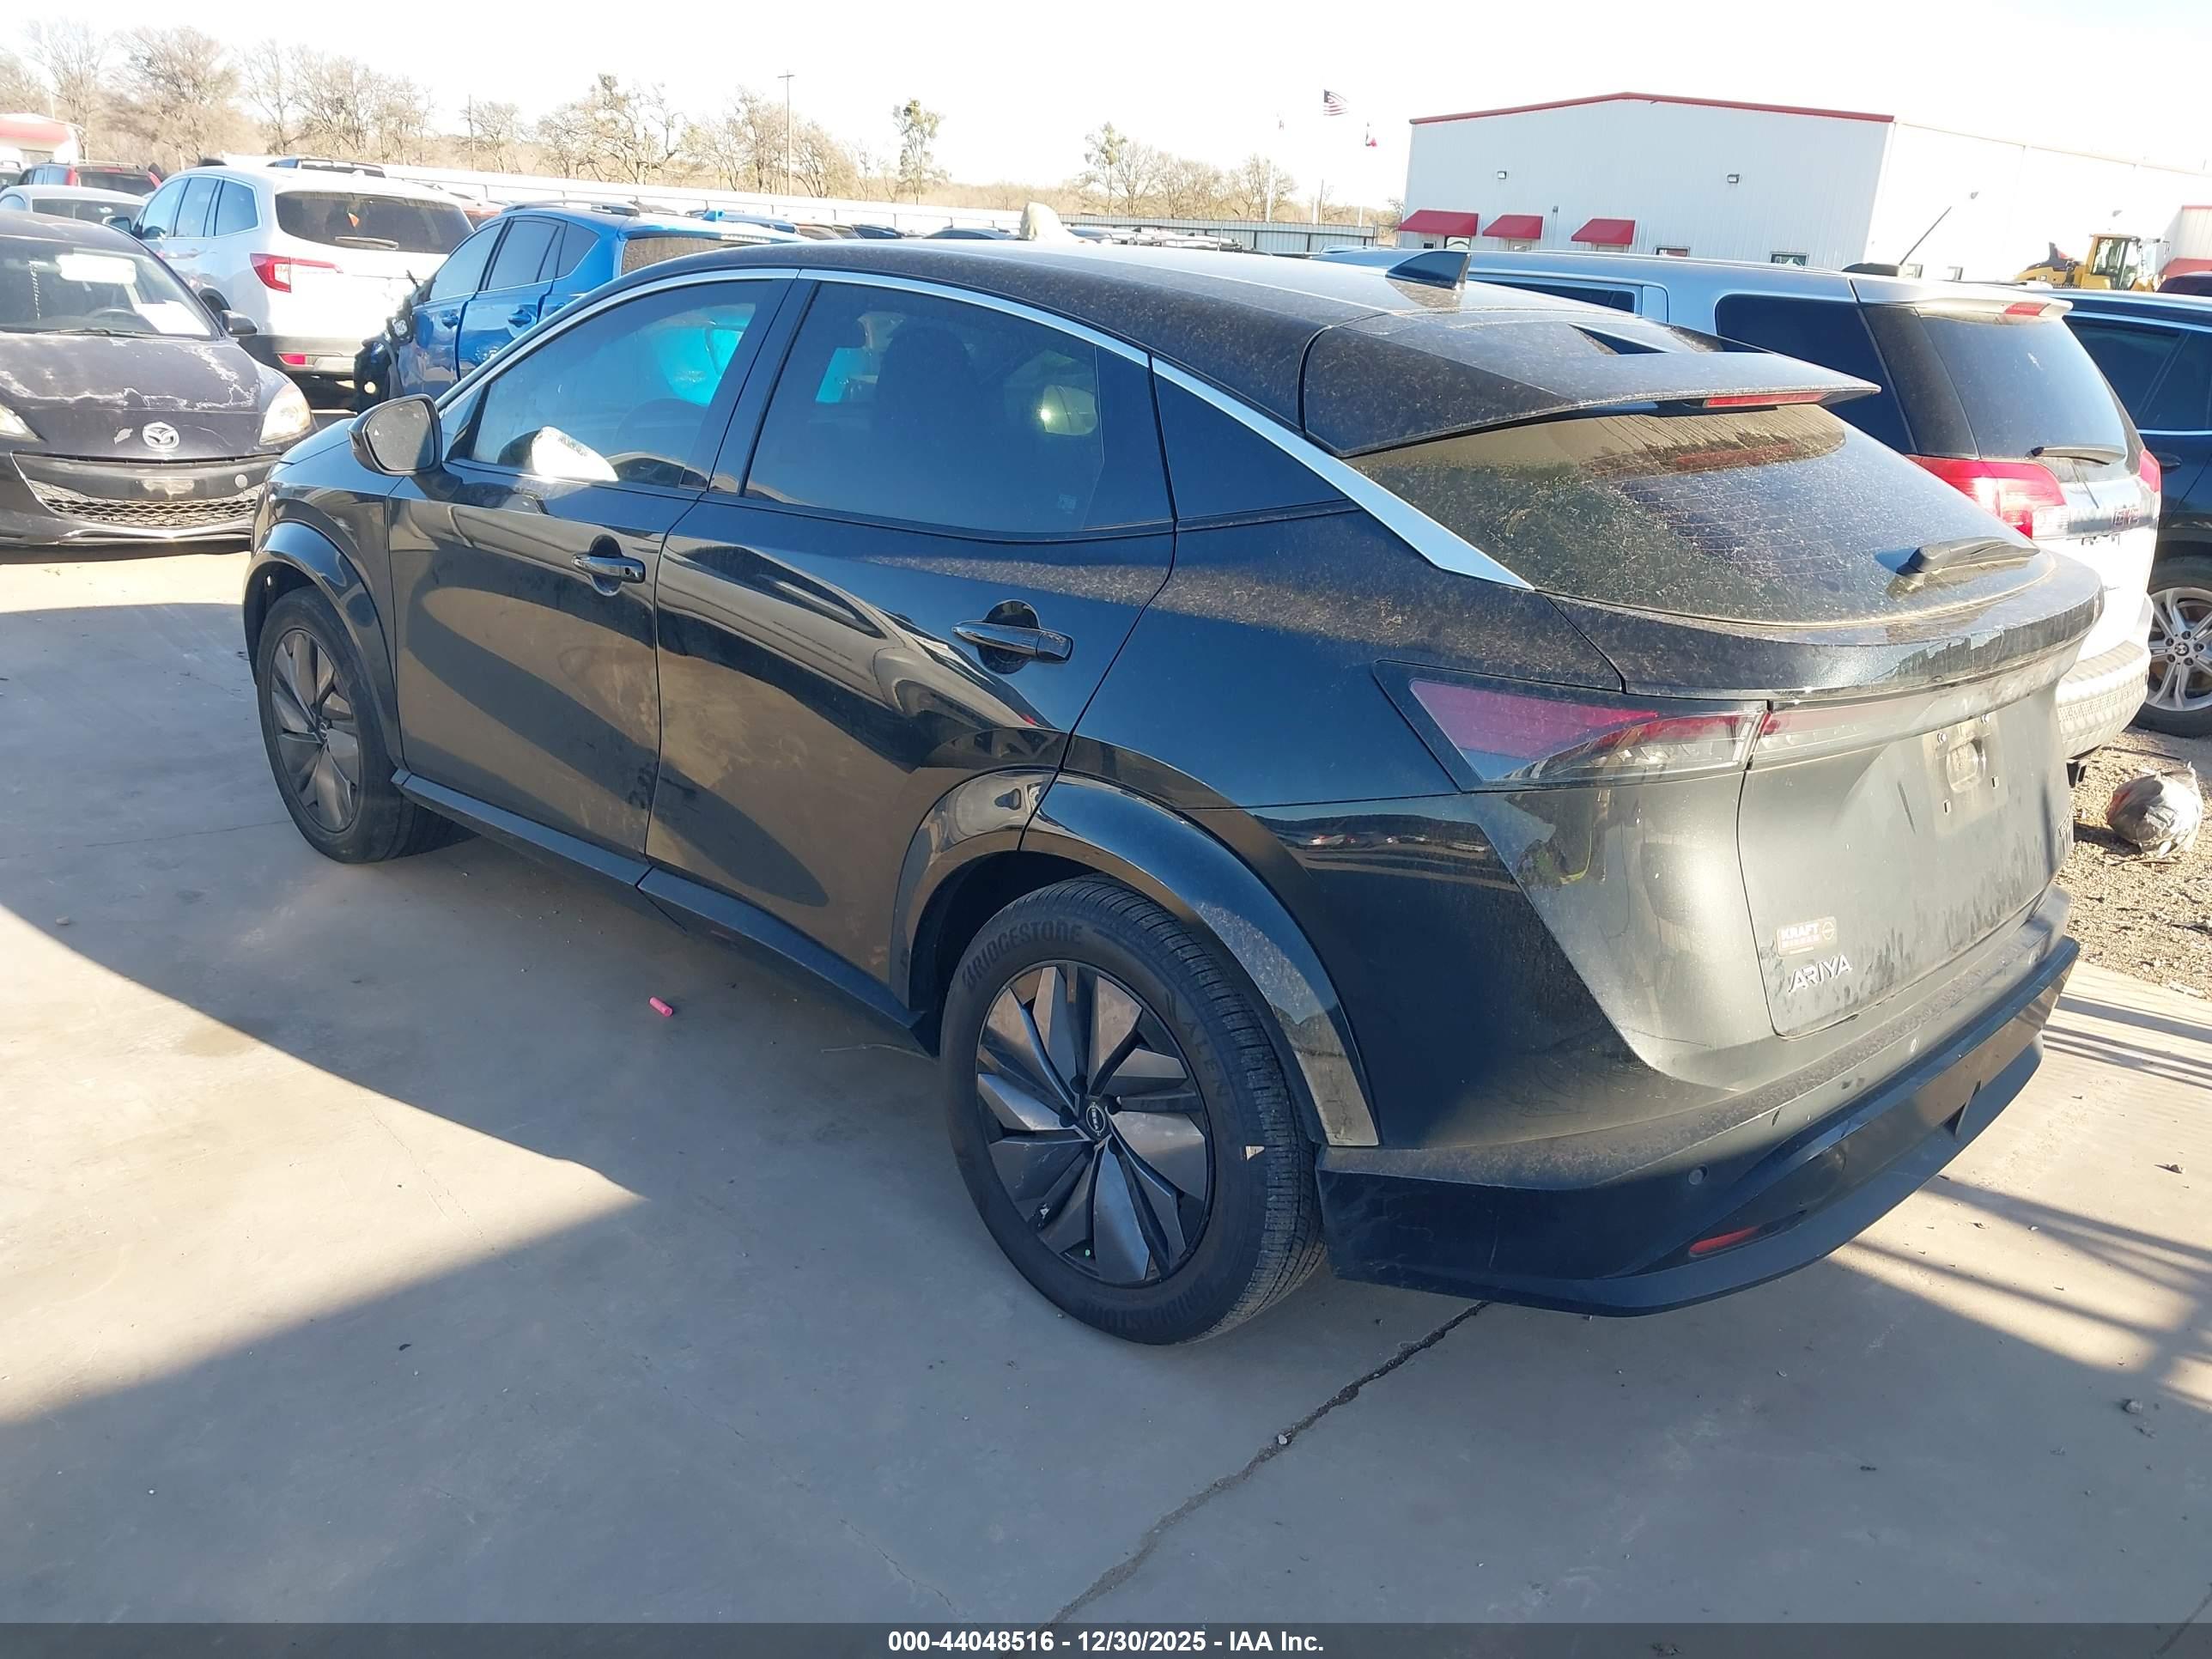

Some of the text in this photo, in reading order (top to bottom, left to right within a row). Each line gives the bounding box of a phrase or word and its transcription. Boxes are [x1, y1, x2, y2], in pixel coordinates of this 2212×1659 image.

[1780, 922, 1820, 941] KRAFT
[961, 920, 1083, 989] BRIDGESTONE
[1787, 954, 1852, 994] ARIYA
